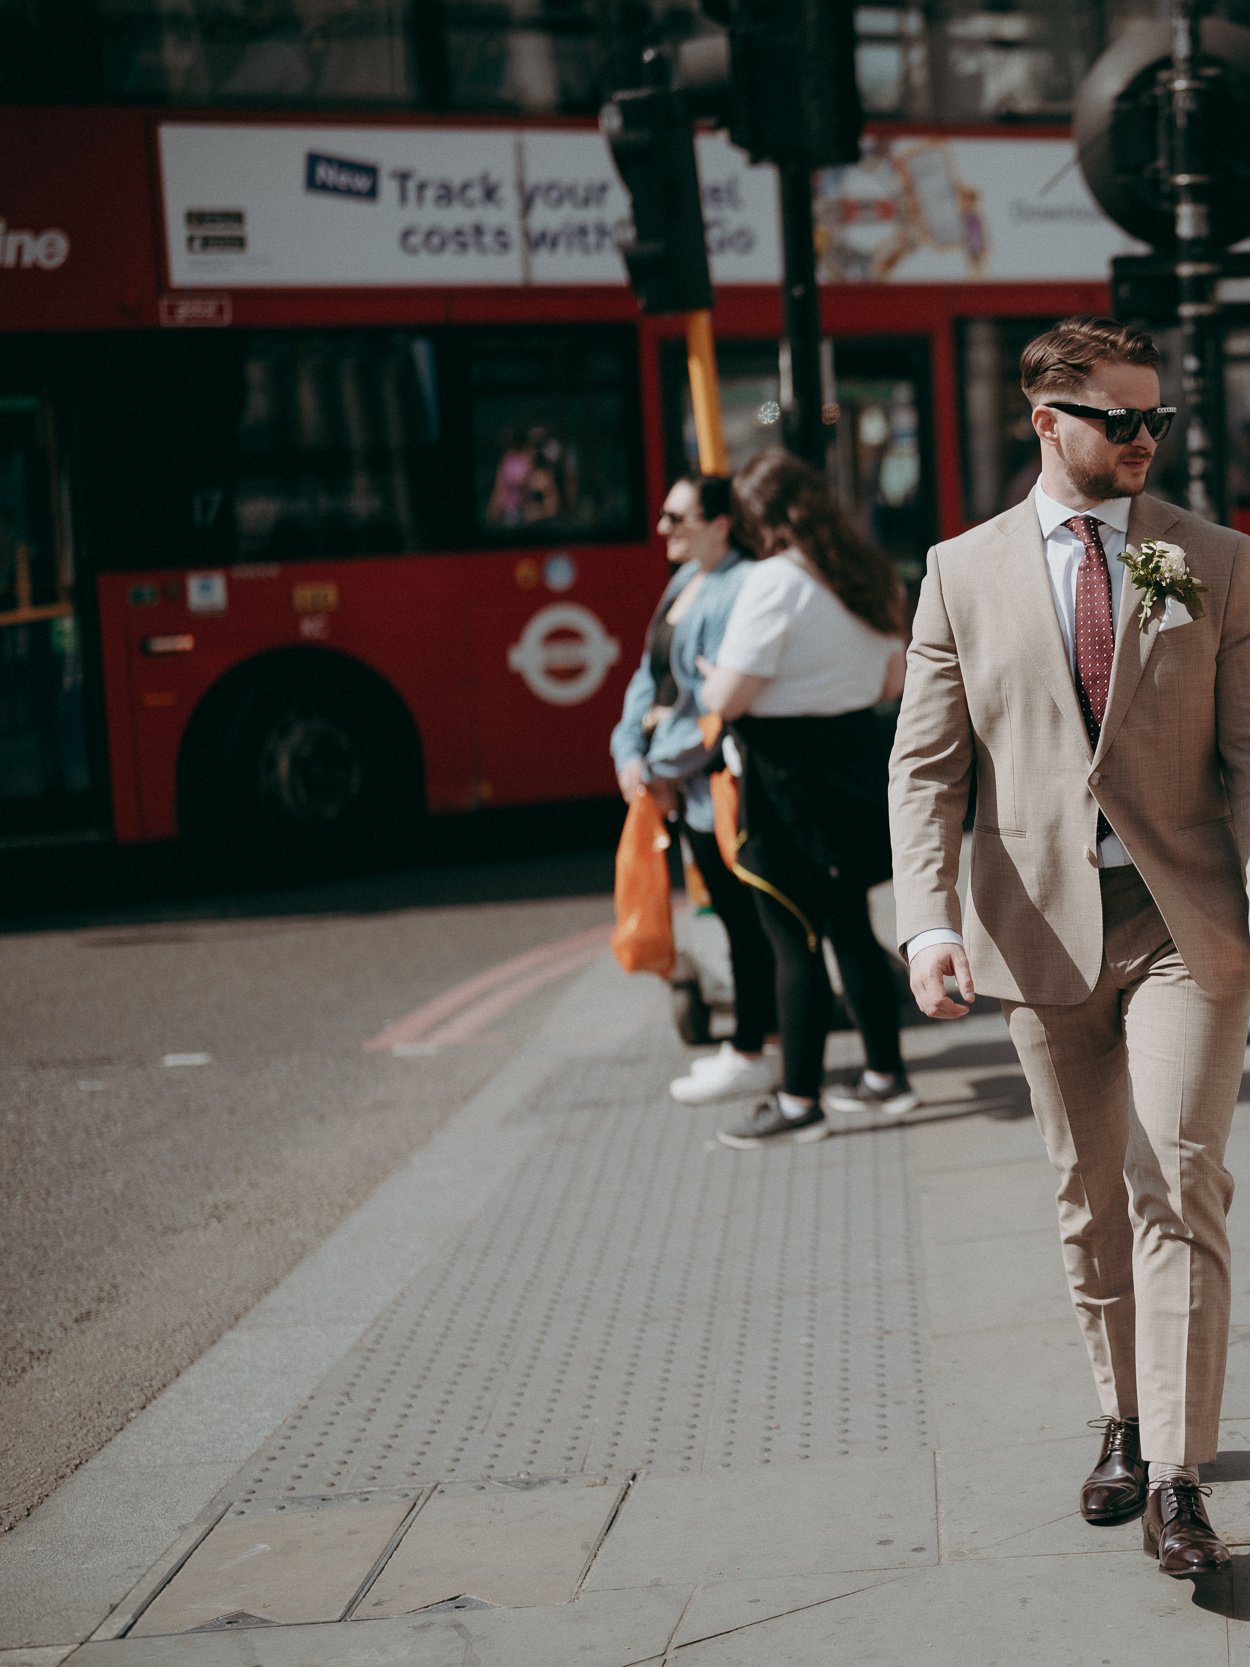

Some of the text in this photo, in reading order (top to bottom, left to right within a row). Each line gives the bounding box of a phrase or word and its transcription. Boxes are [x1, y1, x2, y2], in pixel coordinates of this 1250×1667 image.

[313, 159, 376, 195] New
[391, 168, 609, 224] Track your
[401, 222, 510, 256] costs
